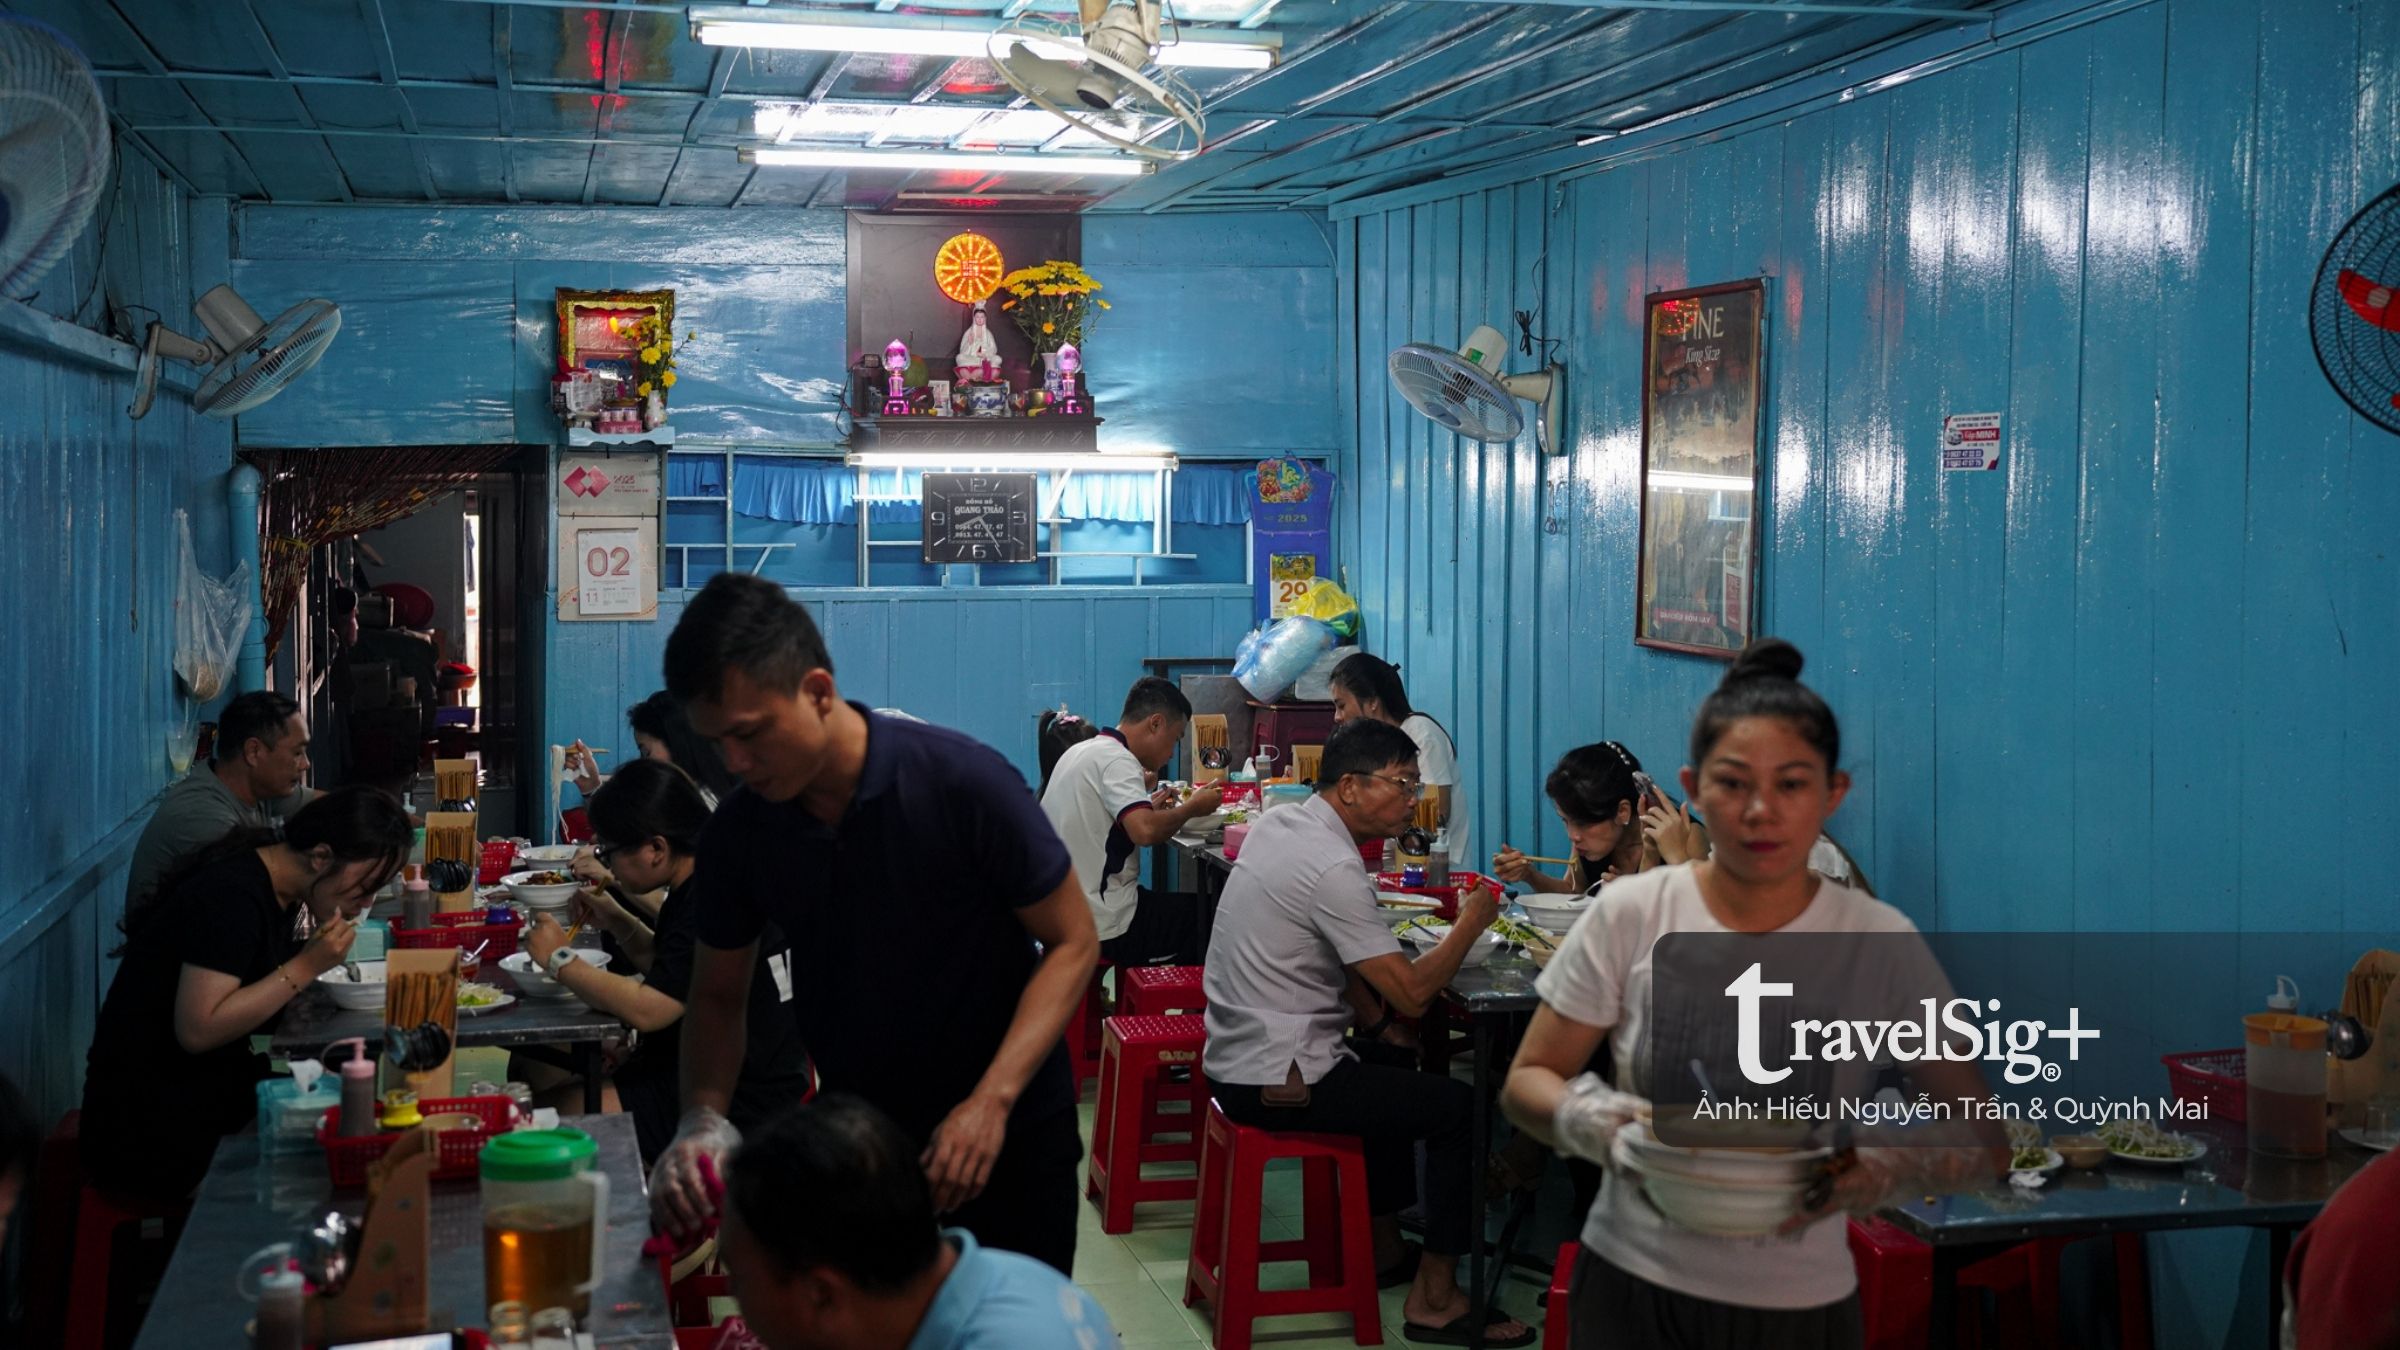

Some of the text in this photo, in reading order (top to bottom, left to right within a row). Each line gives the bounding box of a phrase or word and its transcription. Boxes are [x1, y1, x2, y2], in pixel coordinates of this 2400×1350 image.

[1704, 345, 1721, 362] Size
[969, 477, 987, 493] 12
[931, 511, 945, 526] 9
[954, 506, 981, 516] QUANG
[1012, 511, 1028, 526] 3
[1278, 513, 1308, 523] 2025
[972, 544, 987, 559] 6
[587, 546, 631, 577] 02
[1279, 581, 1309, 603] 29
